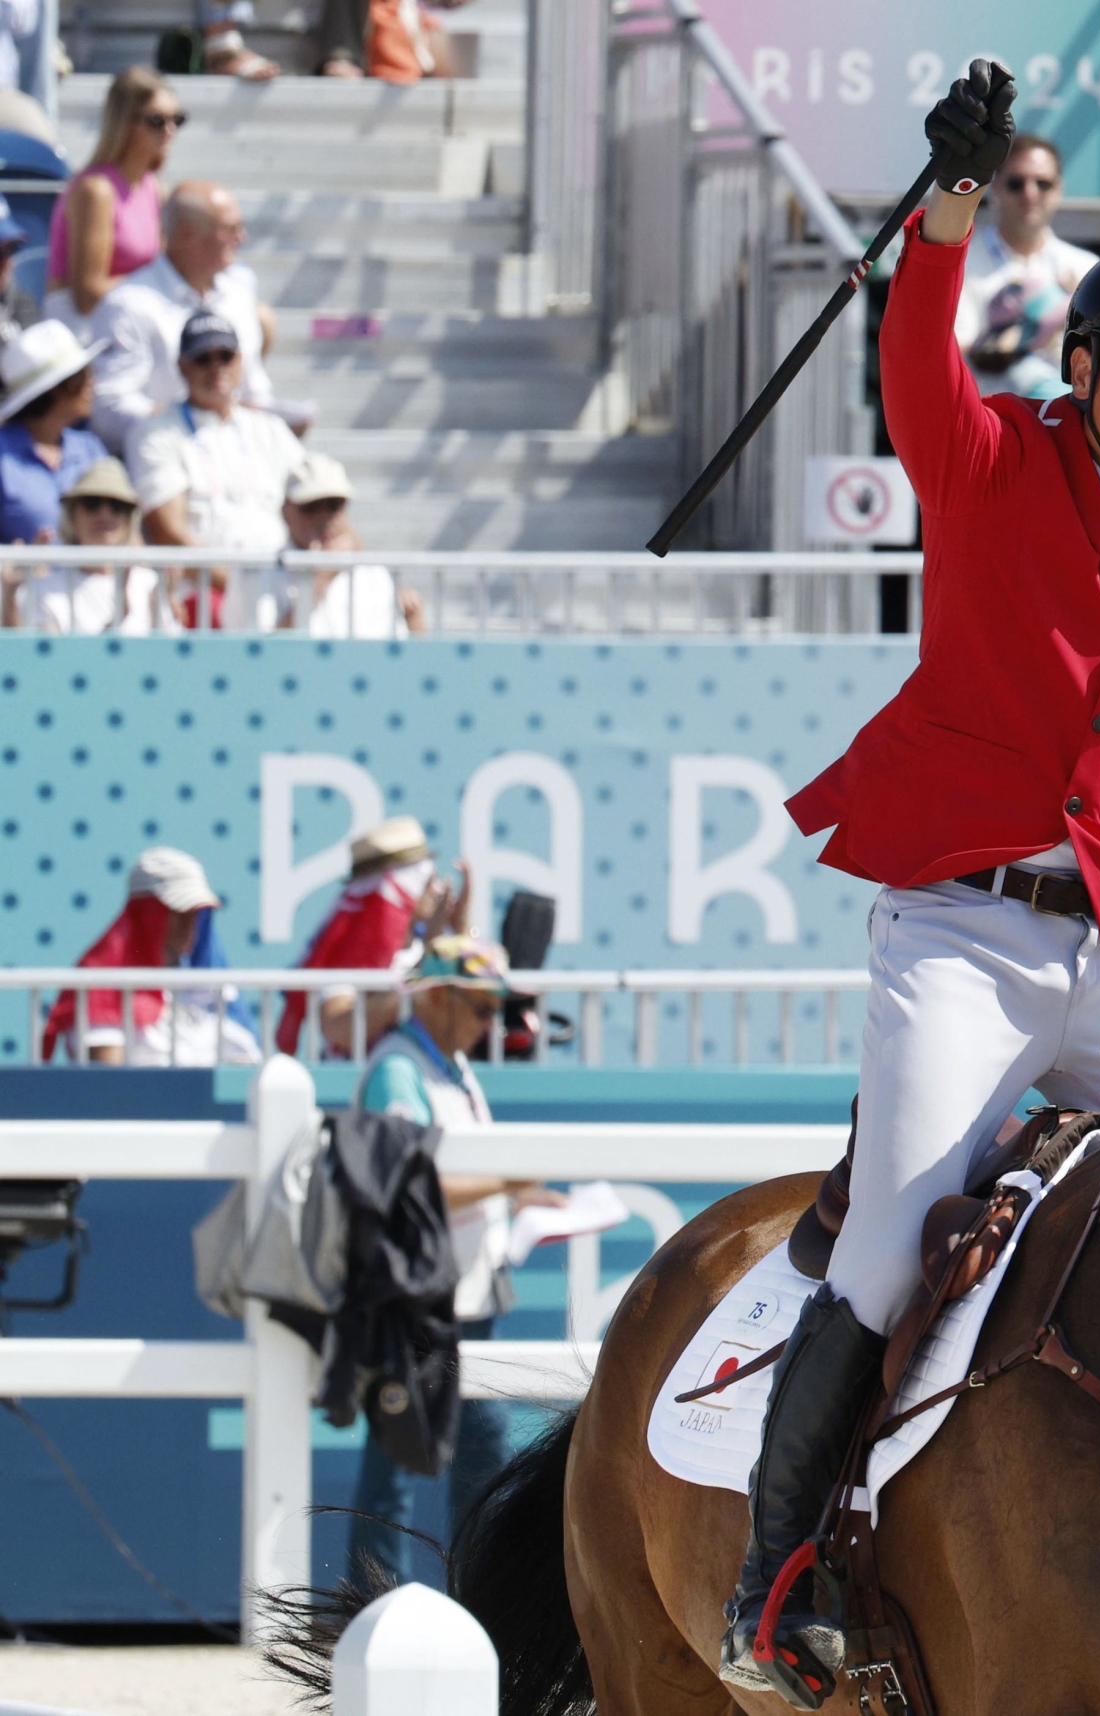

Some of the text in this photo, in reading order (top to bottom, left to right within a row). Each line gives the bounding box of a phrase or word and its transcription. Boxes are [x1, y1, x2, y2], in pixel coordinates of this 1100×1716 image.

[752, 46, 875, 104] RIS
[259, 751, 798, 944] PAR
[748, 1302, 767, 1319] 75
[679, 1408, 723, 1434] JAPAN
